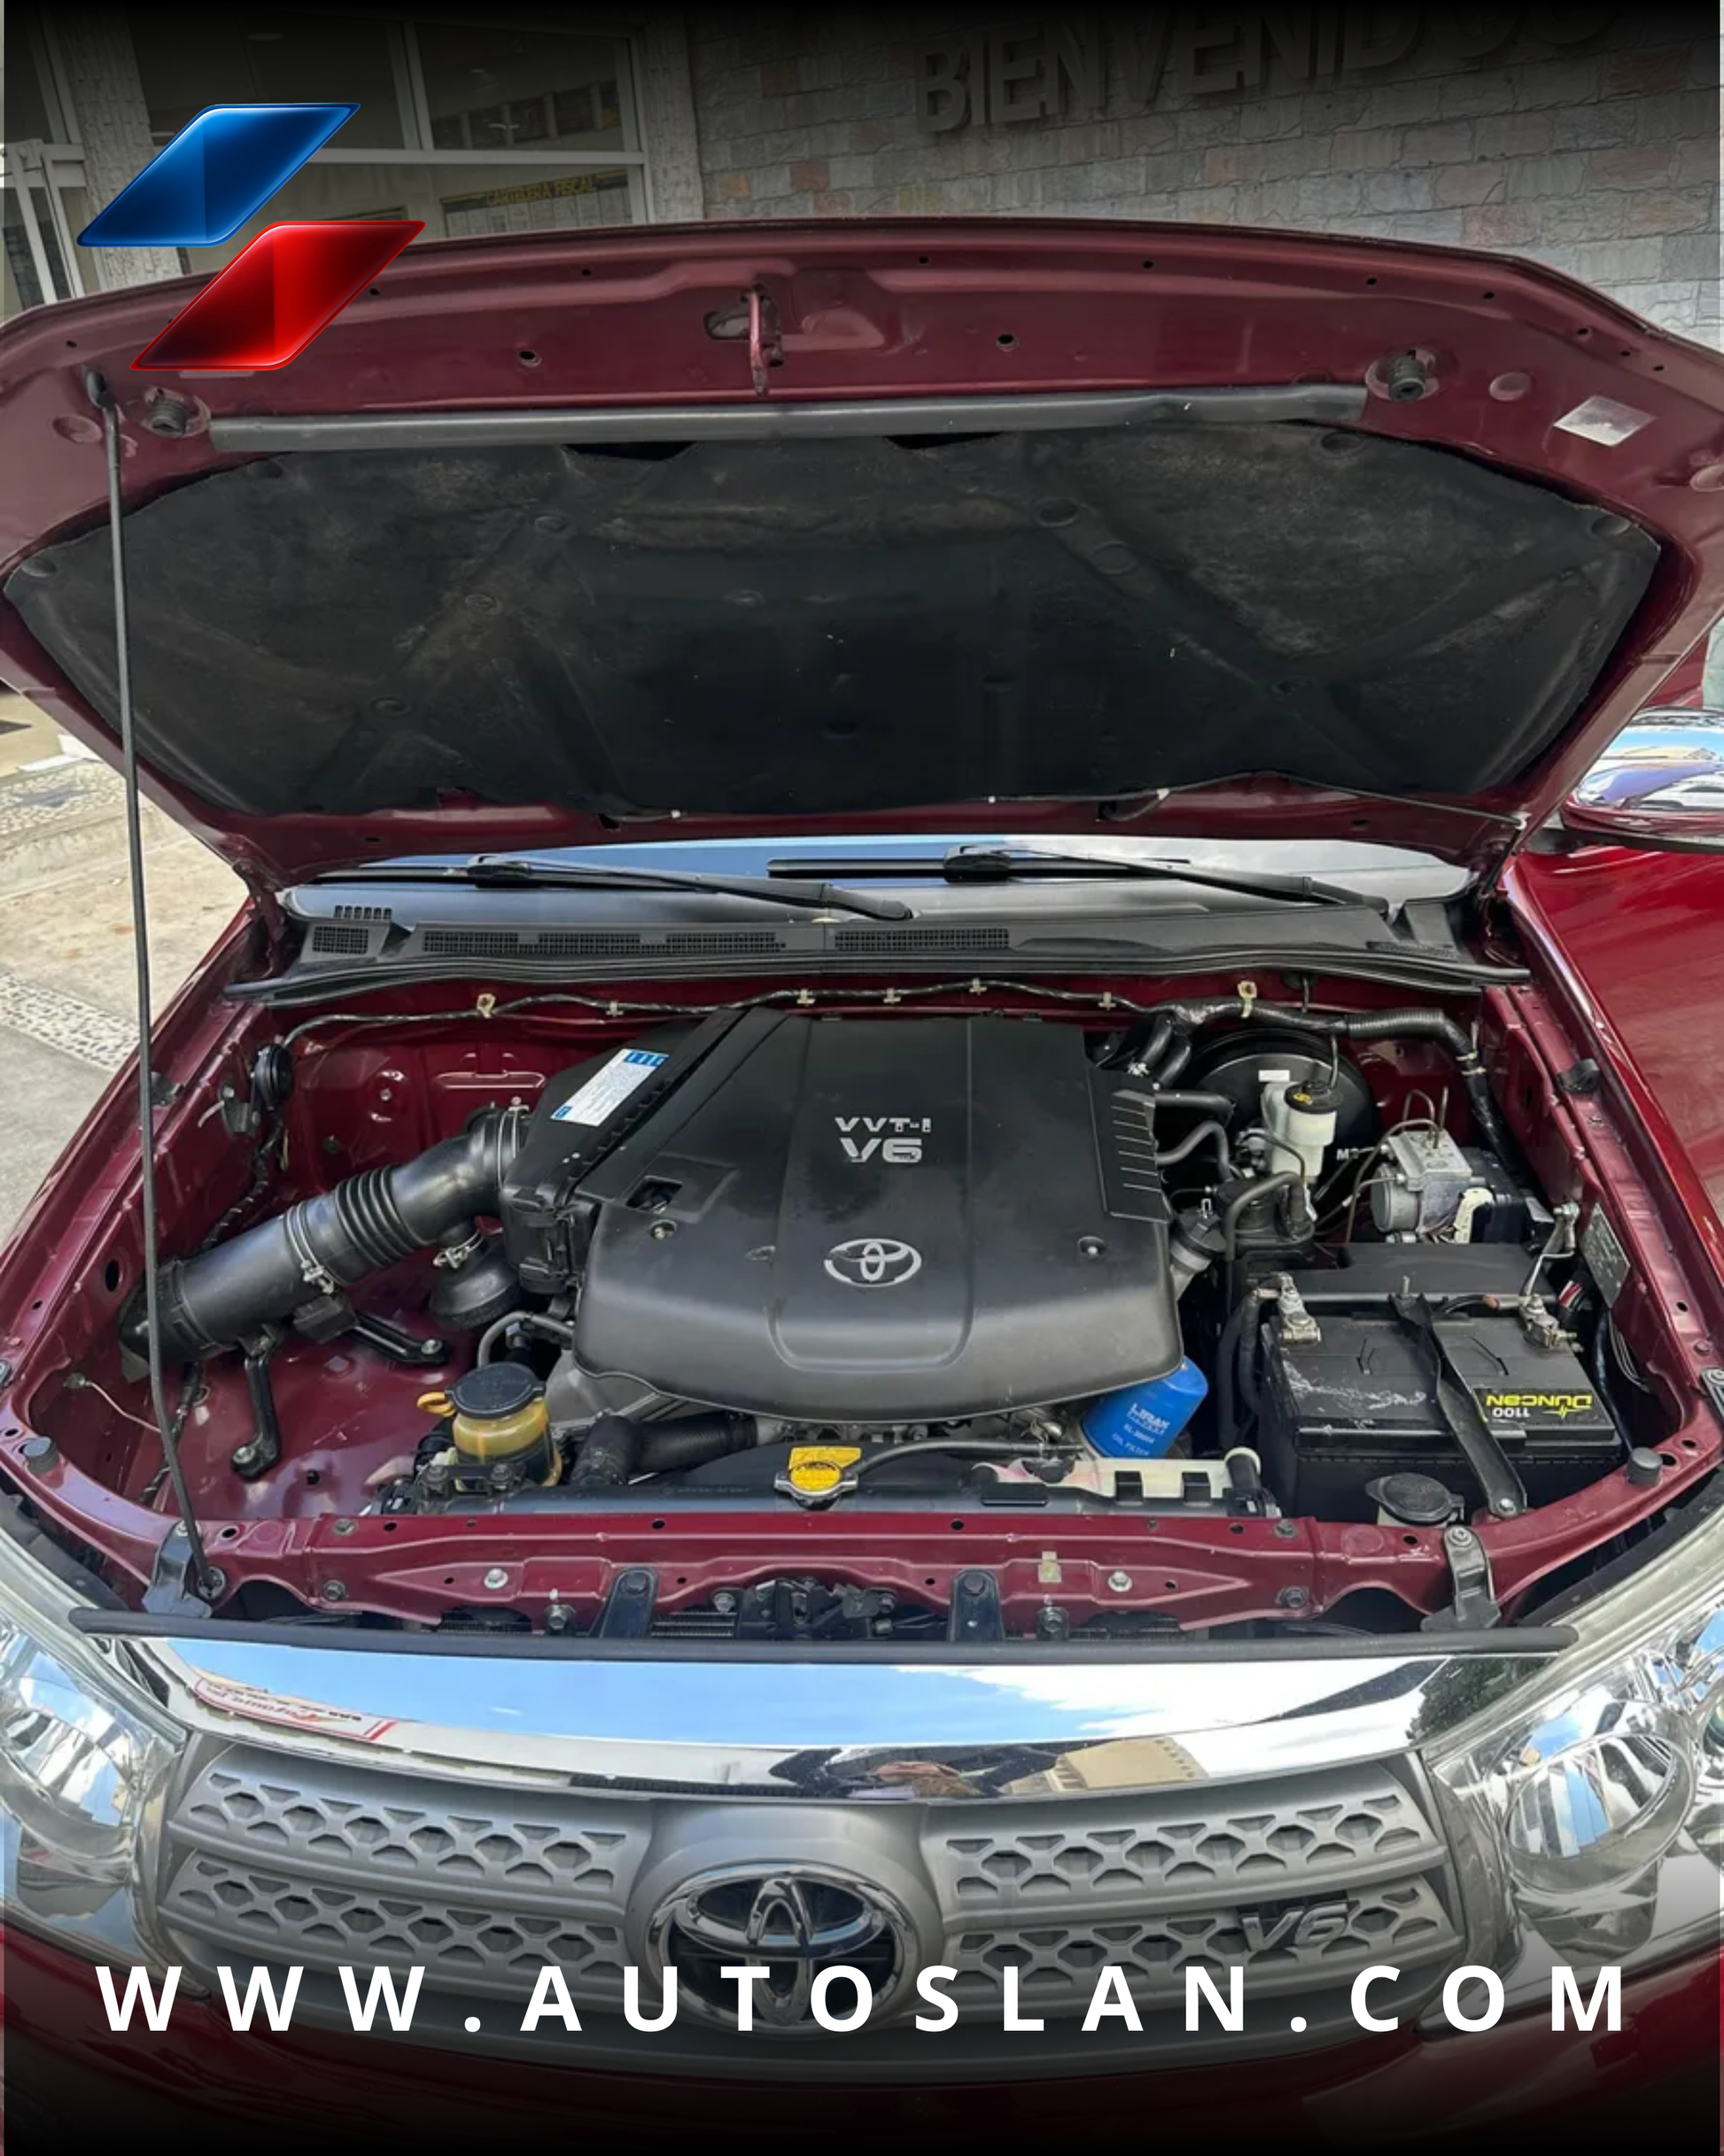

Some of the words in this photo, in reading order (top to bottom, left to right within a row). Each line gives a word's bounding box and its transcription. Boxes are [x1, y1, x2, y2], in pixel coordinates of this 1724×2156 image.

[840, 1137, 922, 1164] V6
[1492, 1407, 1530, 1418] 1100
[1242, 1903, 1348, 1952] V6
